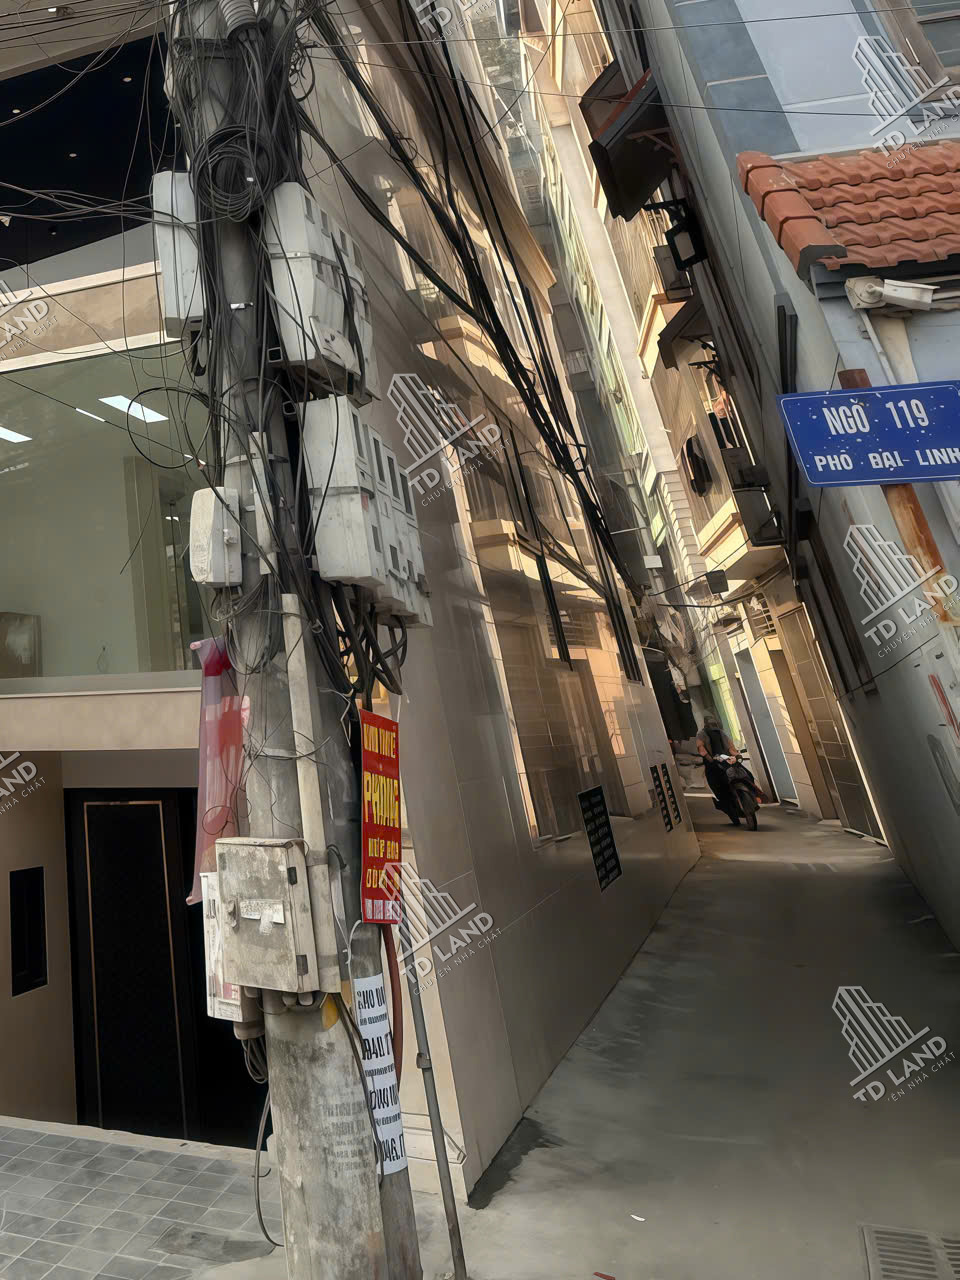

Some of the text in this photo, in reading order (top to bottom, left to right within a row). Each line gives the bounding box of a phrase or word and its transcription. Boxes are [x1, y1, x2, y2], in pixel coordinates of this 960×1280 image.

[822, 398, 930, 436] NGÕ 119
[868, 450, 904, 472] ĐẠI
[915, 447, 960, 466] LINH
